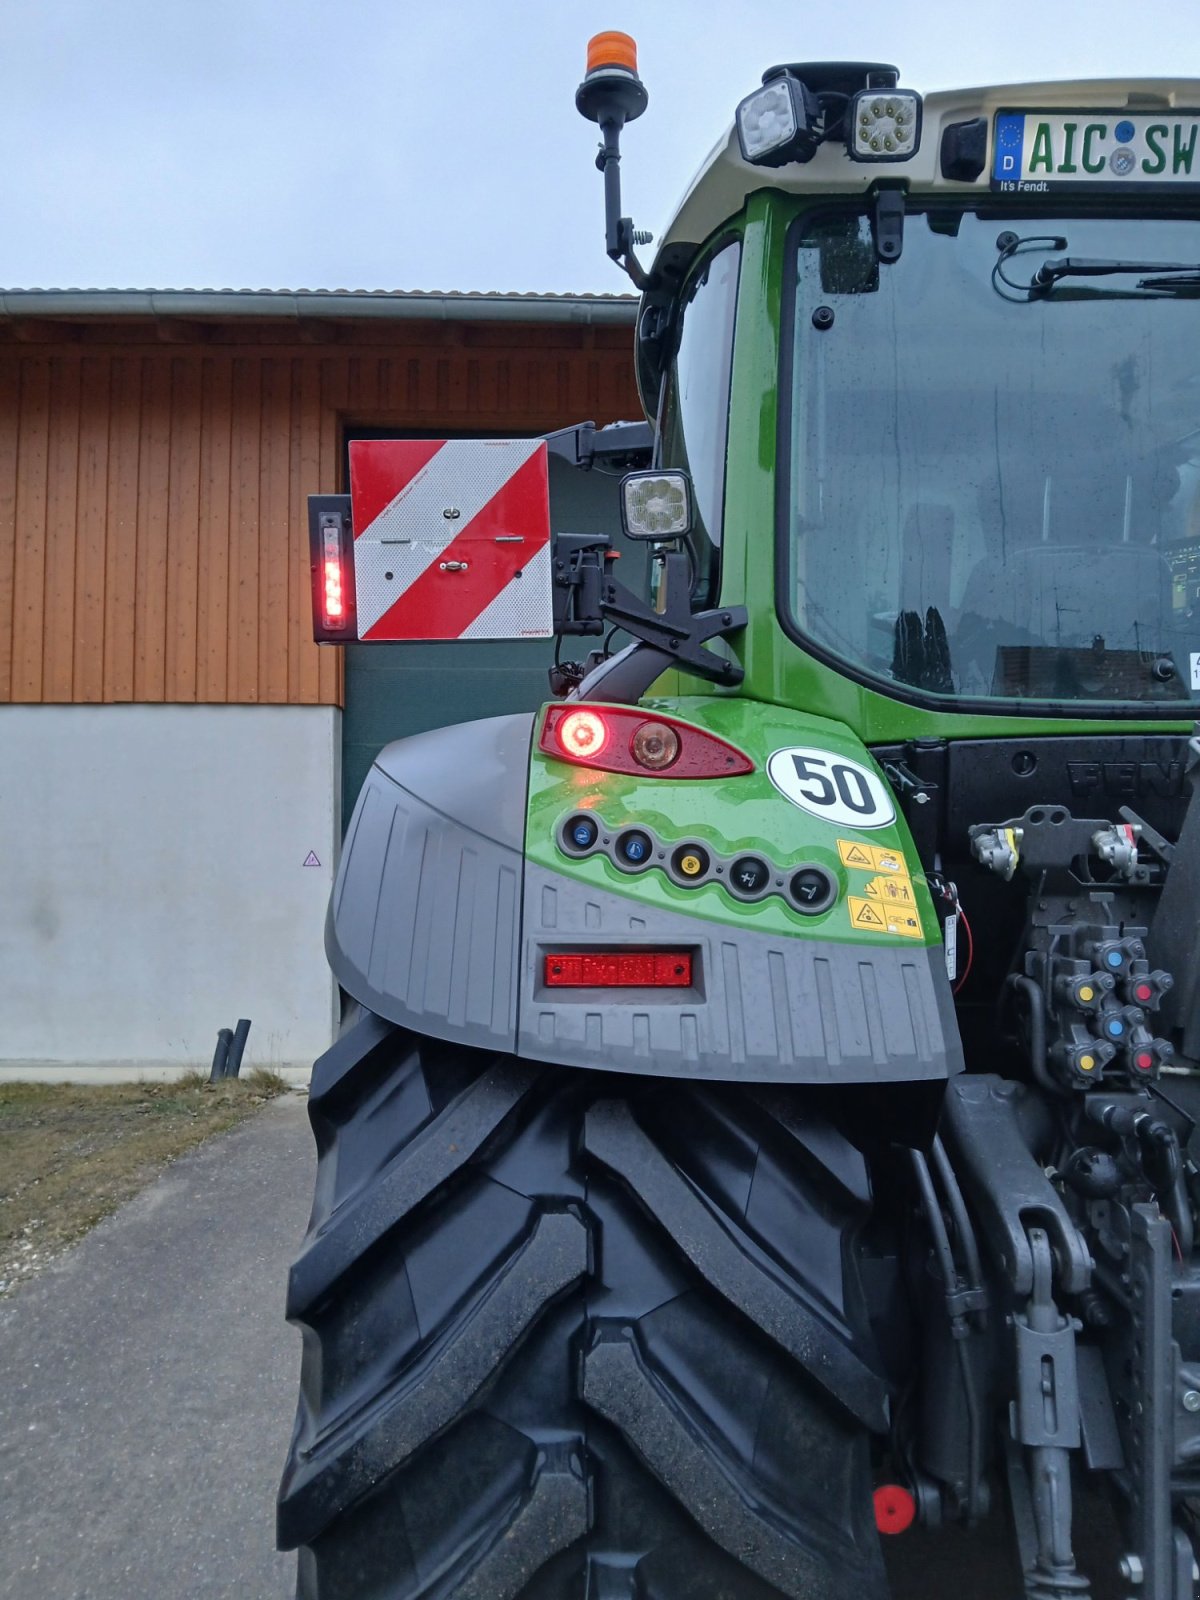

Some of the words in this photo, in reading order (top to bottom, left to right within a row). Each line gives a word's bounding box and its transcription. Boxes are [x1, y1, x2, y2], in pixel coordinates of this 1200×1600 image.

[1002, 156, 1014, 170] D
[1029, 123, 1107, 173] AIC
[1142, 124, 1198, 175] SW
[1000, 180, 1015, 191] It's
[1017, 180, 1050, 192] Fendt.
[791, 754, 876, 814] 50
[1067, 760, 1191, 798] FEN
